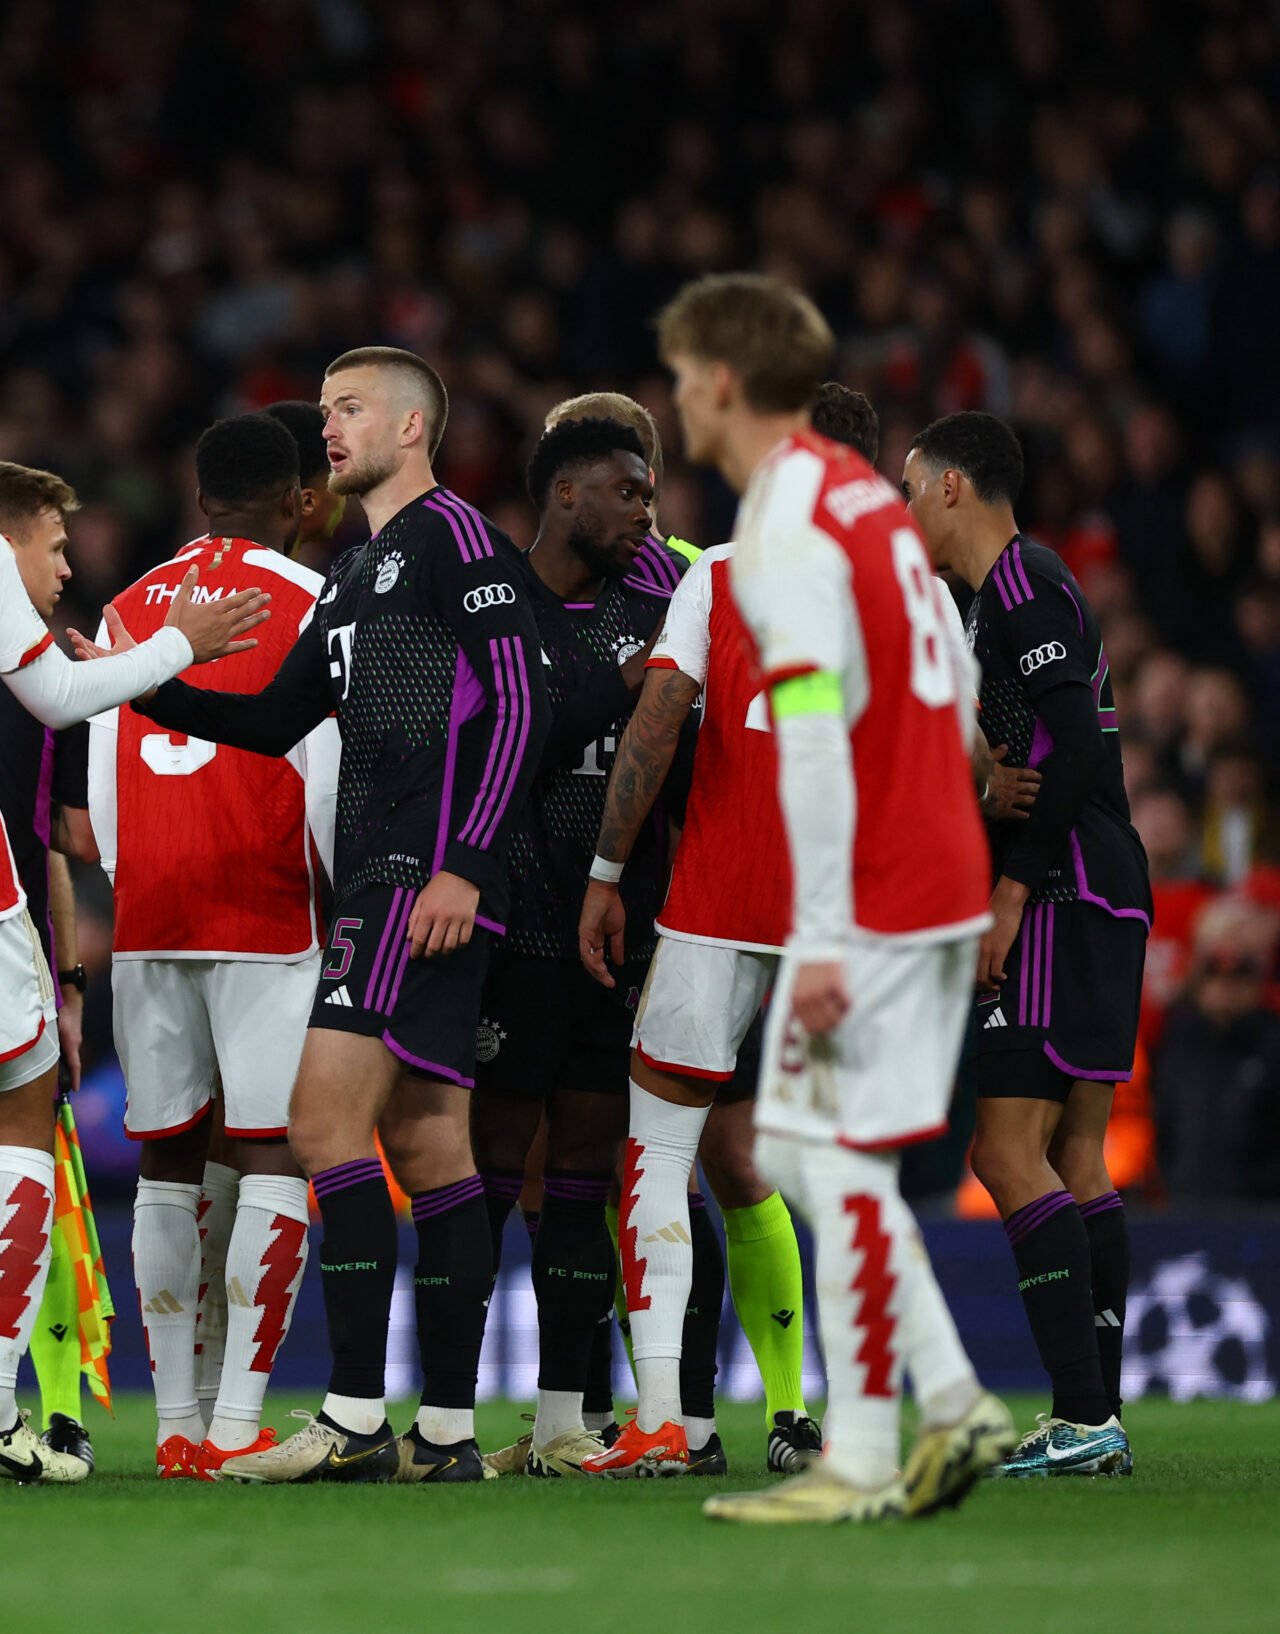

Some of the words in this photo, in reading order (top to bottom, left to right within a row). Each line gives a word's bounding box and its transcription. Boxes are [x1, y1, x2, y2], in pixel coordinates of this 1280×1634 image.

[890, 526, 957, 708] 8
[320, 1261, 377, 1272] BAYERN
[548, 1267, 567, 1277] FC
